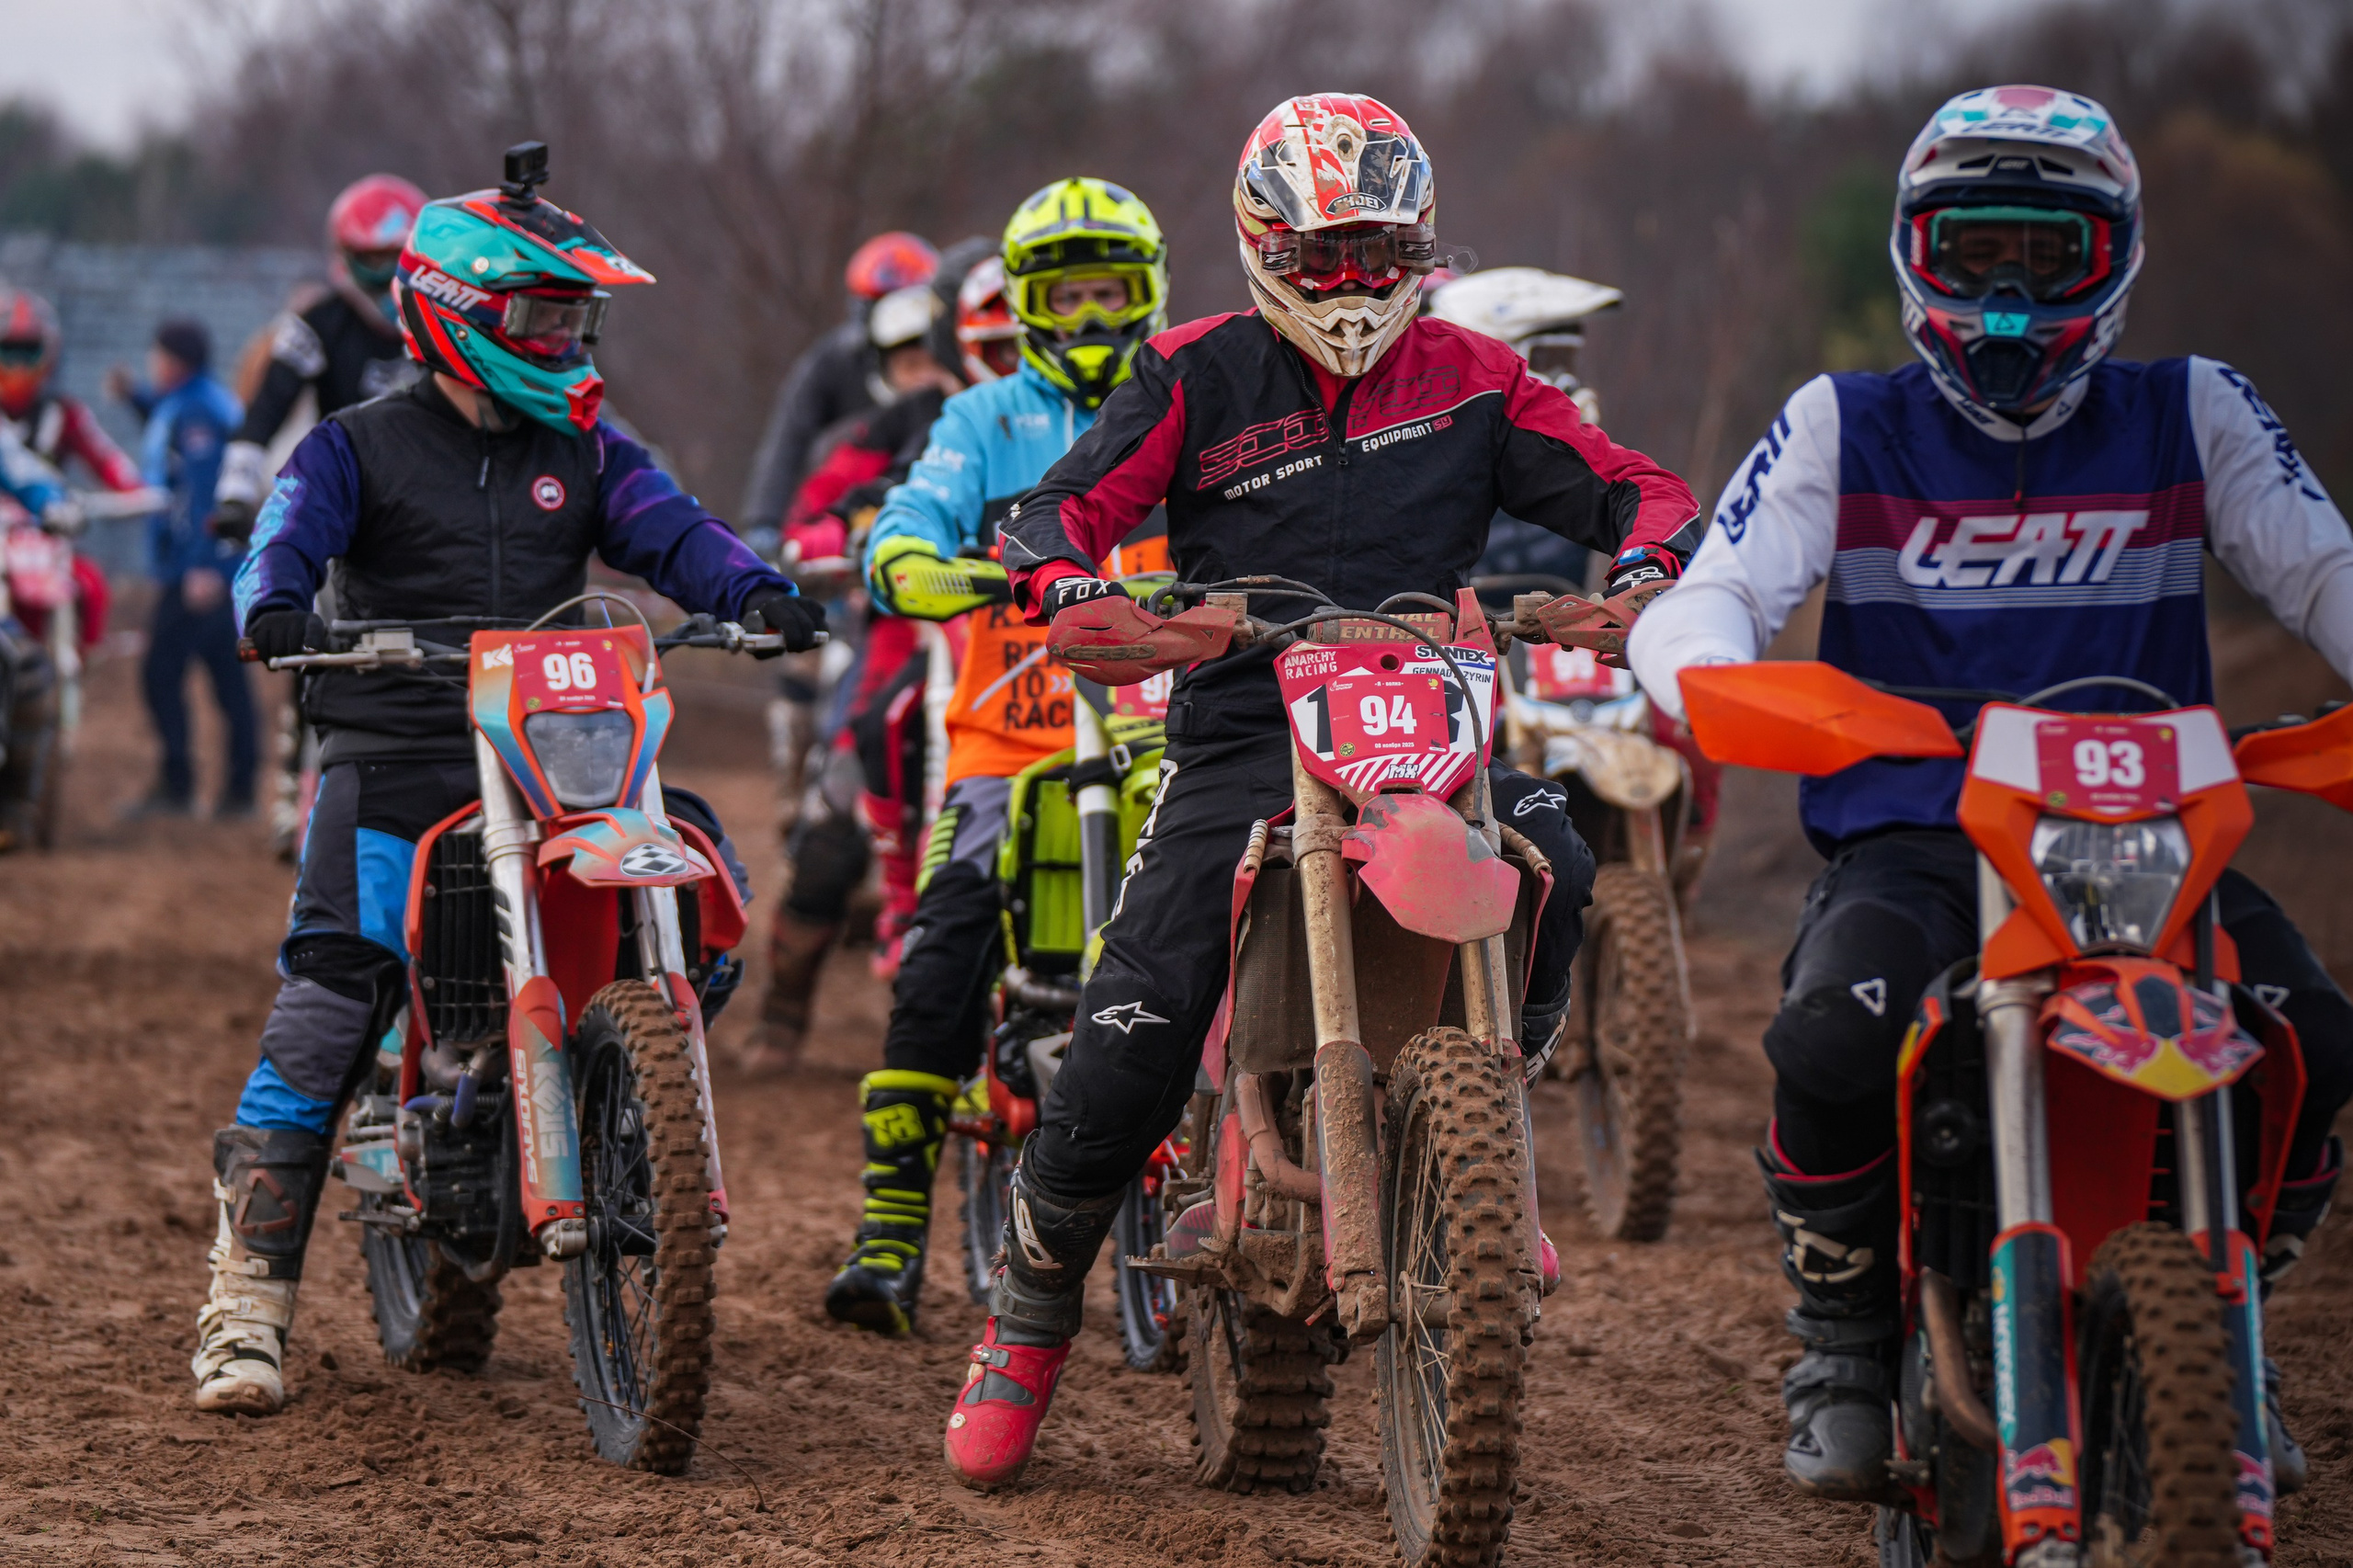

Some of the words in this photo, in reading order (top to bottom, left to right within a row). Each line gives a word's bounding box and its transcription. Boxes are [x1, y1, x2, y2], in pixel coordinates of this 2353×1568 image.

[409, 265, 492, 312] LEATT
[1362, 422, 1433, 453] EQUIPMENT
[1224, 472, 1271, 501] MOTOR
[1276, 455, 1324, 480] SPORT
[1896, 509, 2151, 588] LEATT
[1057, 581, 1111, 605] FOX
[542, 652, 597, 692] 96
[1284, 651, 1337, 668] ANARCHY
[1285, 661, 1338, 680] RACING
[1359, 695, 1417, 736] 94
[2074, 739, 2146, 788] 93
